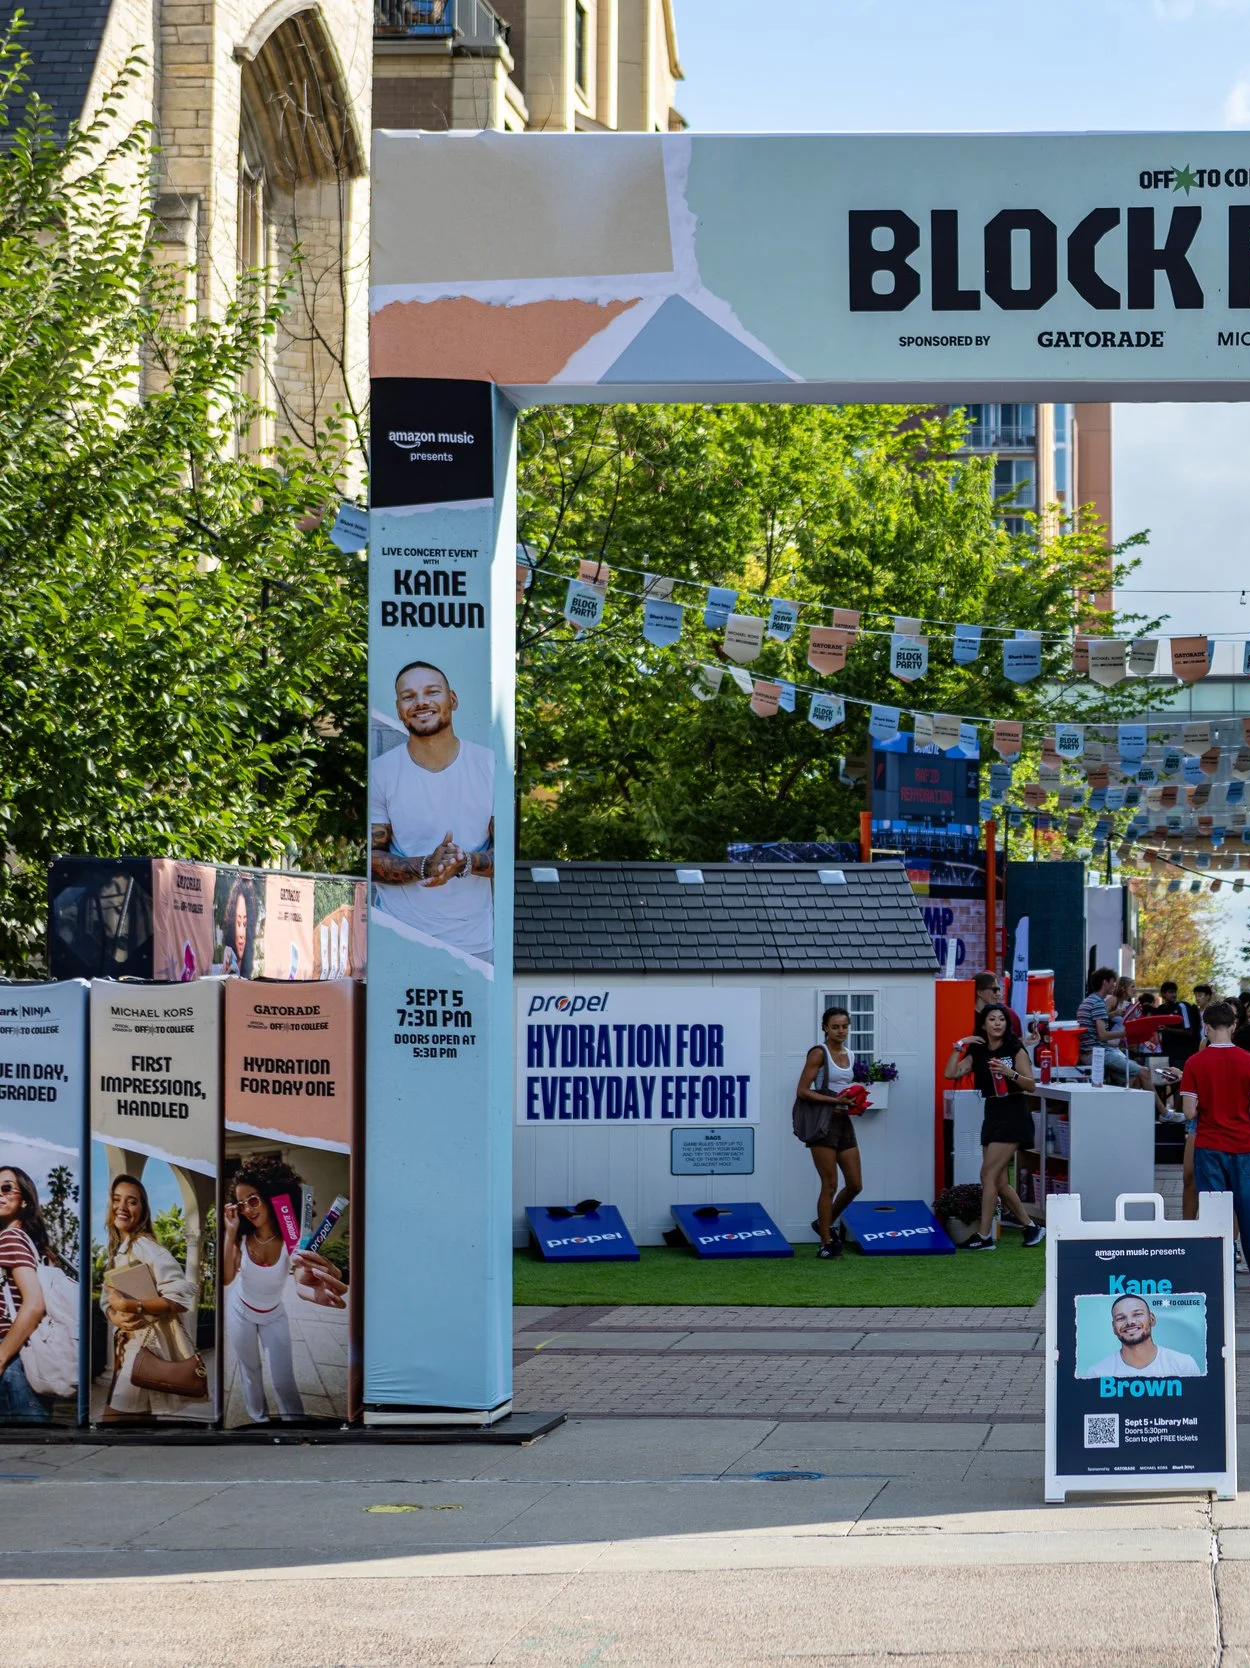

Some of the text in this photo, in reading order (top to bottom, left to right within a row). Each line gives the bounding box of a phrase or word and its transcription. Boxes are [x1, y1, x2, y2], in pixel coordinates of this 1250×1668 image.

[1140, 170, 1174, 189] OFF
[1195, 169, 1220, 188] TO
[848, 205, 1205, 313] BLOCK
[899, 335, 991, 348] SPONSORED BY
[1037, 332, 1164, 349] GATORADE
[389, 430, 474, 447] amazon music
[410, 452, 453, 462] presents
[382, 547, 479, 559] LIVE CONCERT EVENT
[394, 569, 467, 596] KANE
[570, 606, 597, 619] PARTY
[572, 598, 599, 611] BLOCK
[381, 601, 485, 628] BROWN
[896, 661, 923, 669] PARTY
[897, 653, 922, 661] BLOCK
[406, 988, 464, 1007] SEPT 5
[527, 992, 609, 1017] propel
[22, 1006, 51, 1018] NINJA
[111, 1006, 194, 1018] MICHAEL KORS
[253, 1005, 320, 1015] GATORADE
[396, 1008, 473, 1028] 7:30 PM
[20, 1027, 30, 1035] TO
[31, 1025, 60, 1035] COLLEGE
[134, 1025, 149, 1034] OFF
[156, 1026, 165, 1034] TO
[166, 1025, 195, 1033] COLLEGE
[270, 1022, 284, 1030] OFF
[291, 1023, 300, 1031] TO
[301, 1022, 329, 1031] COLLEGE
[394, 1034, 476, 1045] DOORS OPEN AT
[527, 1024, 725, 1068] HYDRATION FOR
[413, 1047, 458, 1058] 5:30 PM
[131, 1055, 172, 1073] FIRST
[243, 1056, 331, 1075] HYDRATION
[16, 1063, 31, 1079] IN
[33, 1064, 69, 1082] DAY,
[101, 1076, 206, 1100] IMPRESSIONS,
[241, 1077, 336, 1097] FOR DAY ONE
[527, 1075, 751, 1121] EVERYDAY EFFORT
[117, 1099, 190, 1119] HANDLED
[310, 1219, 334, 1253] propel
[547, 1232, 623, 1248] propel
[699, 1229, 773, 1245] propel
[863, 1226, 936, 1241] propel
[1095, 1247, 1186, 1260] amazon music presents
[1108, 1274, 1173, 1295] Kane
[1100, 1376, 1183, 1398] Brown
[1124, 1417, 1198, 1428] Sept 5 Library Mall
[1124, 1427, 1168, 1435] Doors 5:30pm
[1149, 1436, 1160, 1444] get
[1177, 1434, 1199, 1442] tickets
